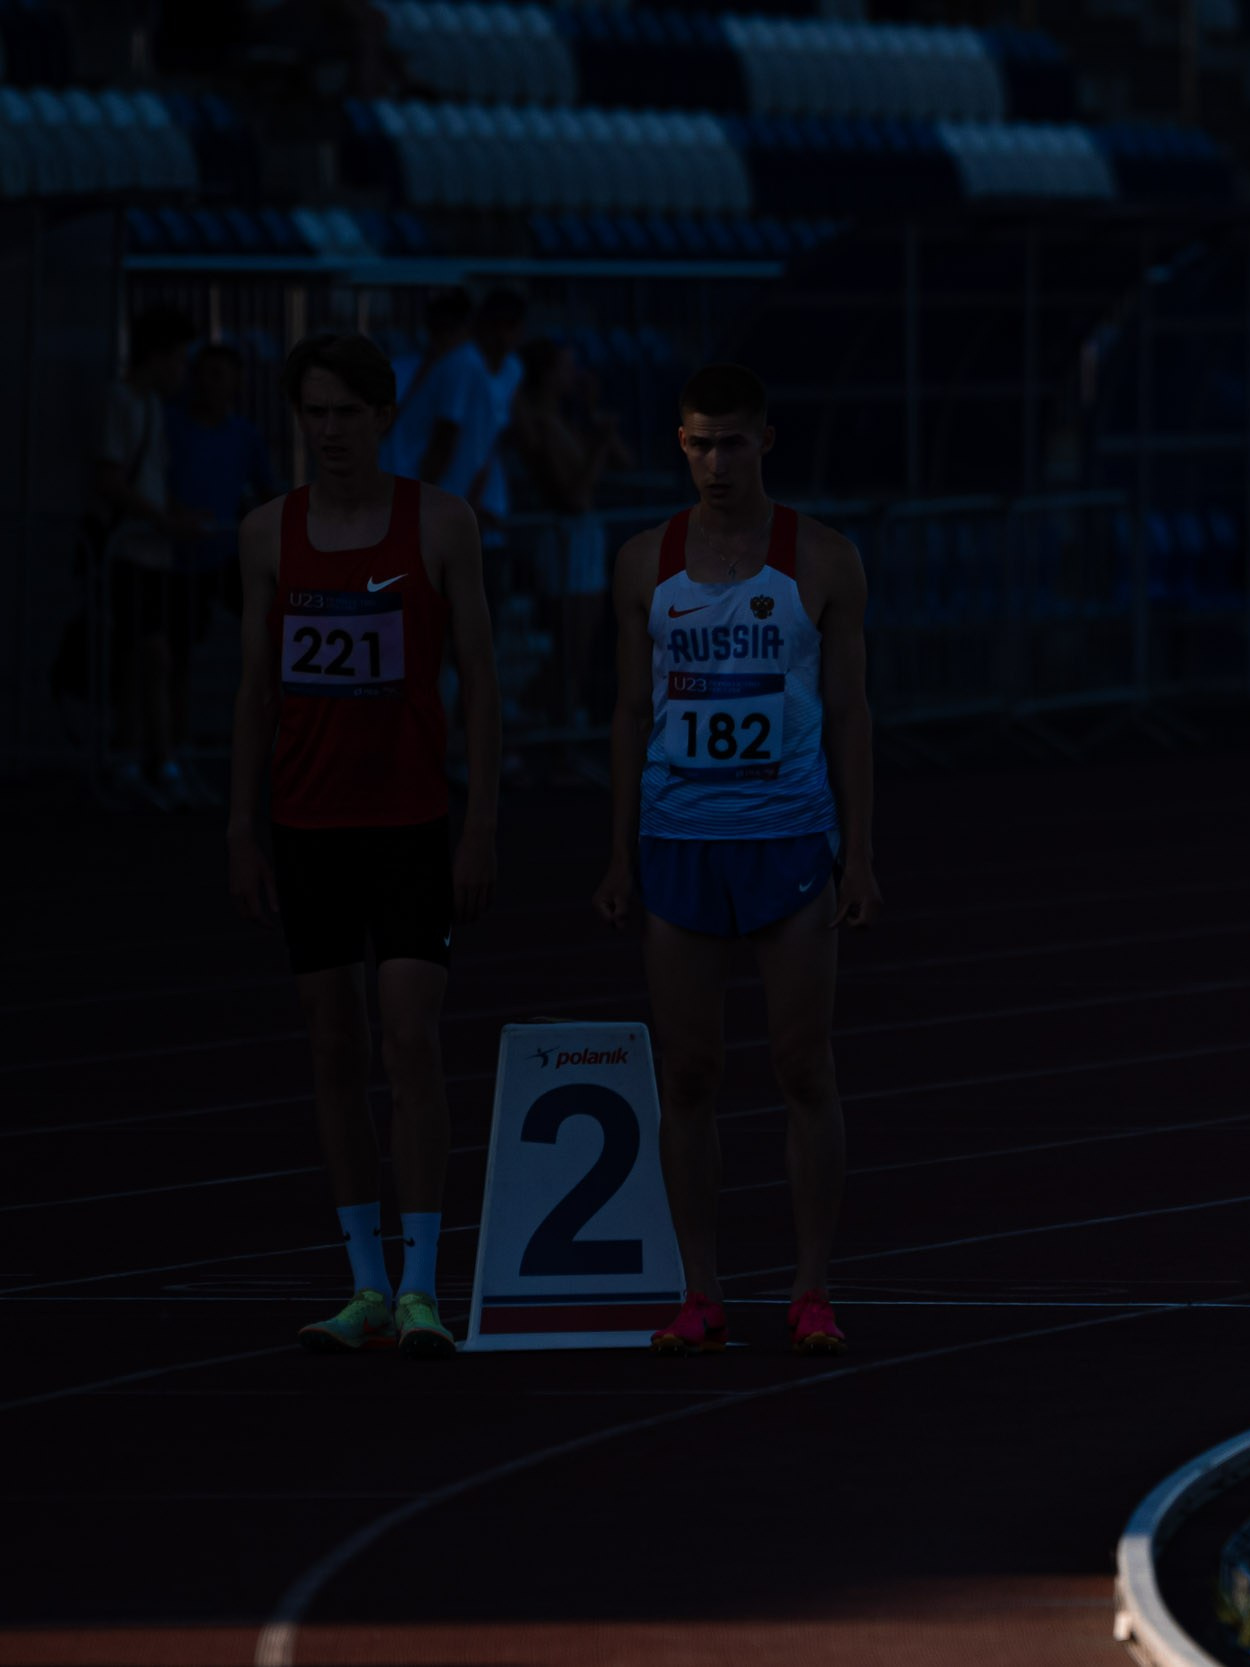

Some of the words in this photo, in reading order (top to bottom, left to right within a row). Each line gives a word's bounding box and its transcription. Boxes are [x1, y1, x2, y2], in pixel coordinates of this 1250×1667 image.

[289, 591, 325, 608] U23
[292, 627, 380, 677] 221
[668, 625, 784, 663] RUSSIA
[673, 676, 708, 692] U23
[681, 712, 771, 760] 182
[556, 1047, 628, 1069] polanik
[519, 1083, 643, 1276] 2
